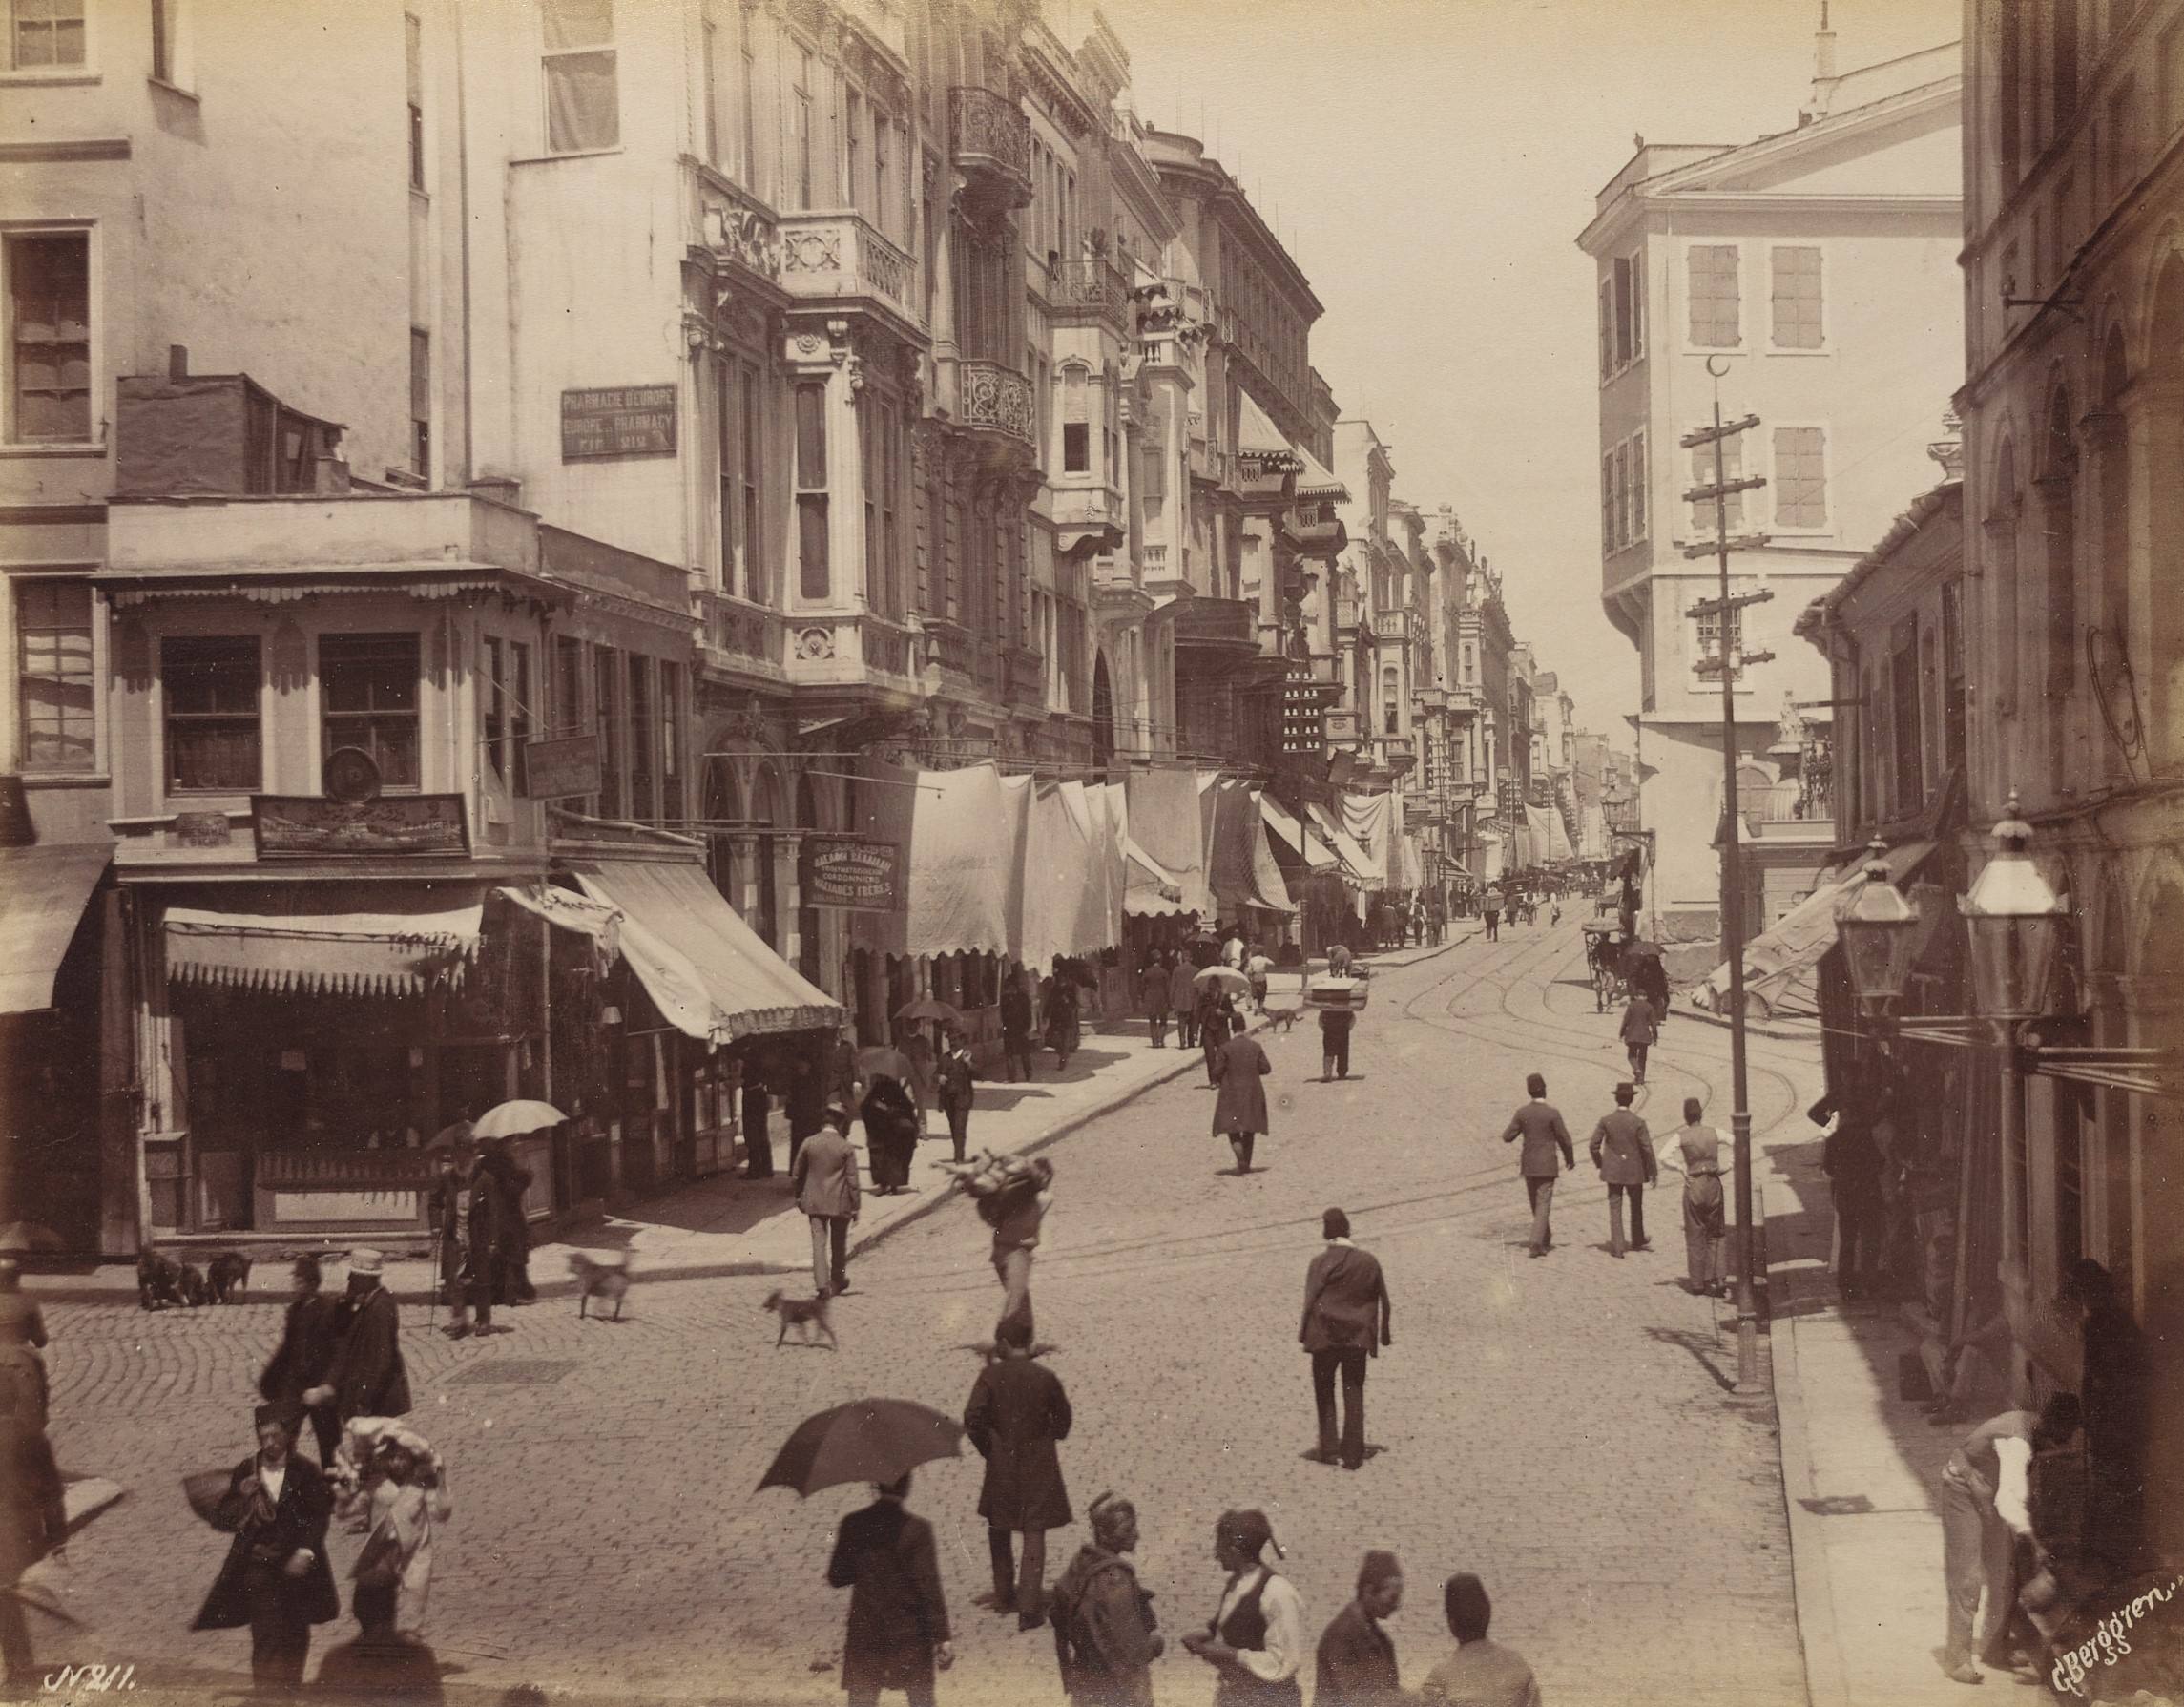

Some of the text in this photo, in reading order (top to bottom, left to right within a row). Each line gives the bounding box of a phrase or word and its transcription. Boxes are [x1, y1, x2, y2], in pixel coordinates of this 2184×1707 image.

[563, 391, 623, 410] PHARMACIE
[614, 414, 673, 432] PHARMACY
[823, 873, 880, 884] CORDONNIERS
